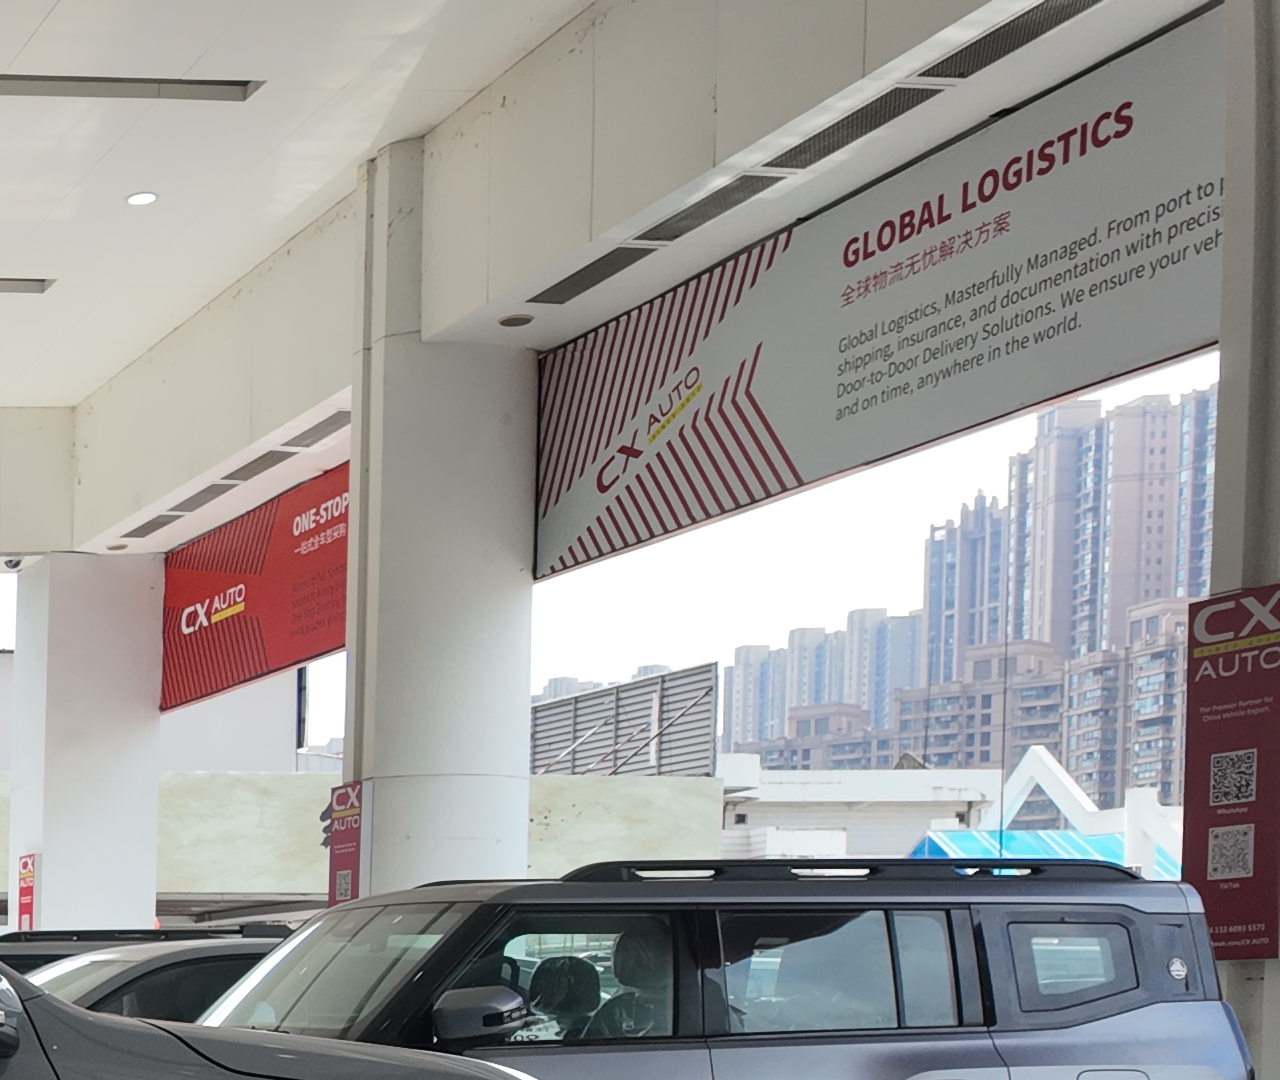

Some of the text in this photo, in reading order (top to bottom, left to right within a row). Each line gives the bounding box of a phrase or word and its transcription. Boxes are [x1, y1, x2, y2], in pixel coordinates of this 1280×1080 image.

[842, 101, 1134, 268] GLOBAL LOGISTICS
[837, 205, 1223, 377] shipping, insurance, and documentation with precis
[838, 323, 878, 353] Global
[881, 301, 942, 334] Logistics,
[944, 264, 1023, 308] Masterfully
[1026, 227, 1102, 274] Managed.
[1107, 209, 1150, 239] From
[1155, 189, 1192, 224] port
[1197, 181, 1215, 201] to
[840, 211, 1011, 308] 全球物流无忧解决方案
[836, 354, 920, 399] Door-to-Door
[923, 331, 979, 365] Delivery
[982, 302, 1056, 342] Solutions.
[1060, 288, 1085, 309] We
[1088, 264, 1145, 298] ensure
[1148, 246, 1190, 280] your
[835, 312, 1083, 422] and on time, anywhere in the world.
[597, 366, 700, 494] CX AUTO
[293, 492, 350, 537] ONE-STOP
[181, 599, 210, 635] CX
[211, 584, 245, 613] AUTO
[1193, 590, 1280, 643] CX
[1194, 646, 1280, 682] AUTO
[332, 785, 360, 811] CX
[332, 815, 359, 832] AUTO
[20, 856, 34, 873] CX
